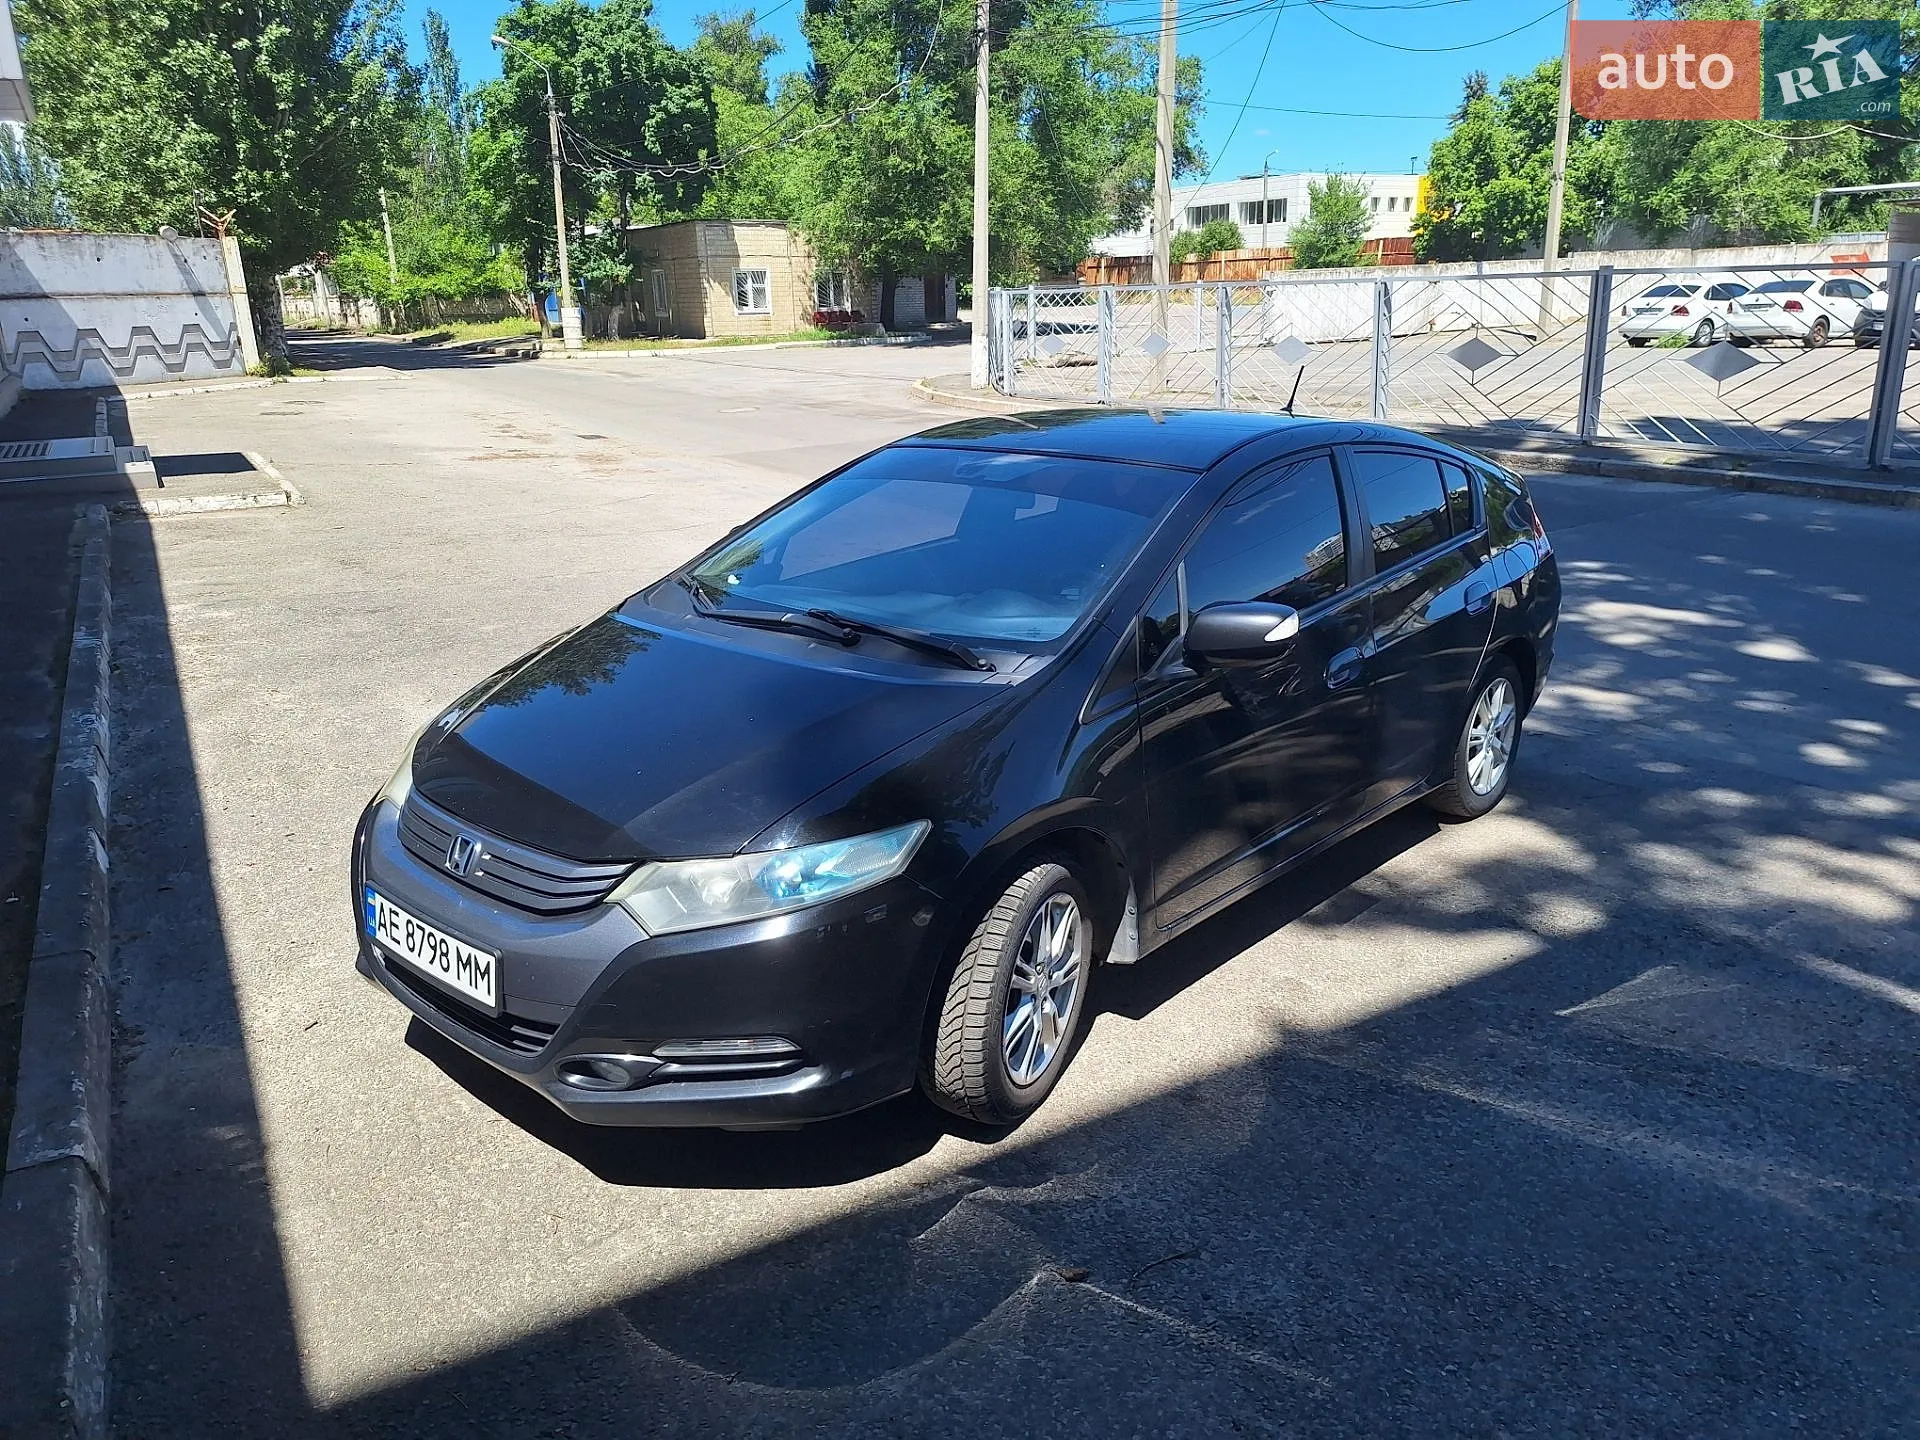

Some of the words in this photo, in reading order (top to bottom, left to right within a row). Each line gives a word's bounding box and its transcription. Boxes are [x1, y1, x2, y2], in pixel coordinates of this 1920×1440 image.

[378, 902, 401, 946] AE
[405, 918, 450, 973] 8798
[456, 945, 491, 996] MM
